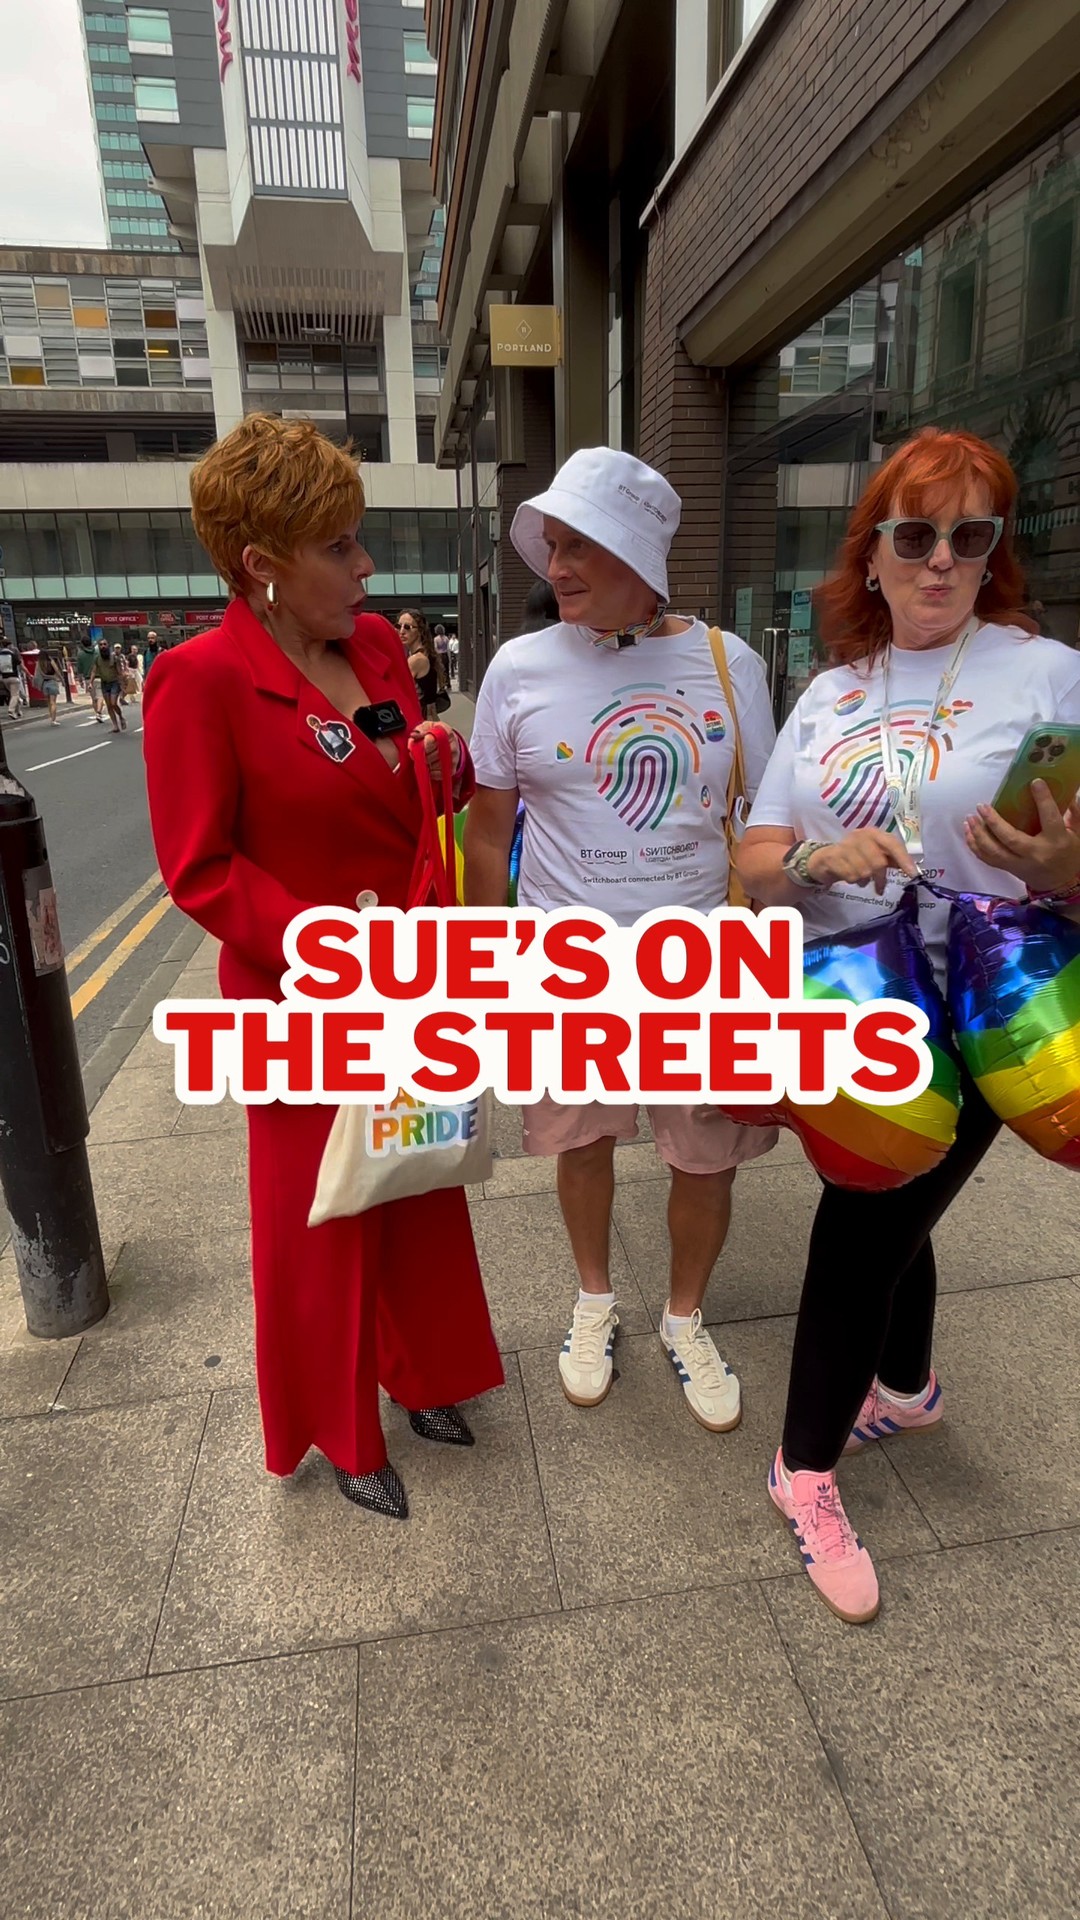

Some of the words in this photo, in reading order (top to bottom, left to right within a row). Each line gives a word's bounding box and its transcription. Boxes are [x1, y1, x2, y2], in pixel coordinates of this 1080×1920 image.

[497, 343, 552, 353] PORTLAND
[26, 616, 65, 625] American
[65, 616, 92, 626] Candy
[580, 849, 593, 859] BT
[594, 849, 628, 860] Group
[645, 842, 696, 857] SWITCHBOARD
[583, 876, 627, 884] Switchboard
[628, 873, 666, 883] connected
[666, 873, 674, 881] by
[674, 871, 682, 879] BT
[846, 893, 884, 906] connected
[884, 899, 895, 909] by
[919, 902, 937, 910] oup
[372, 1106, 479, 1151] PRIDE
